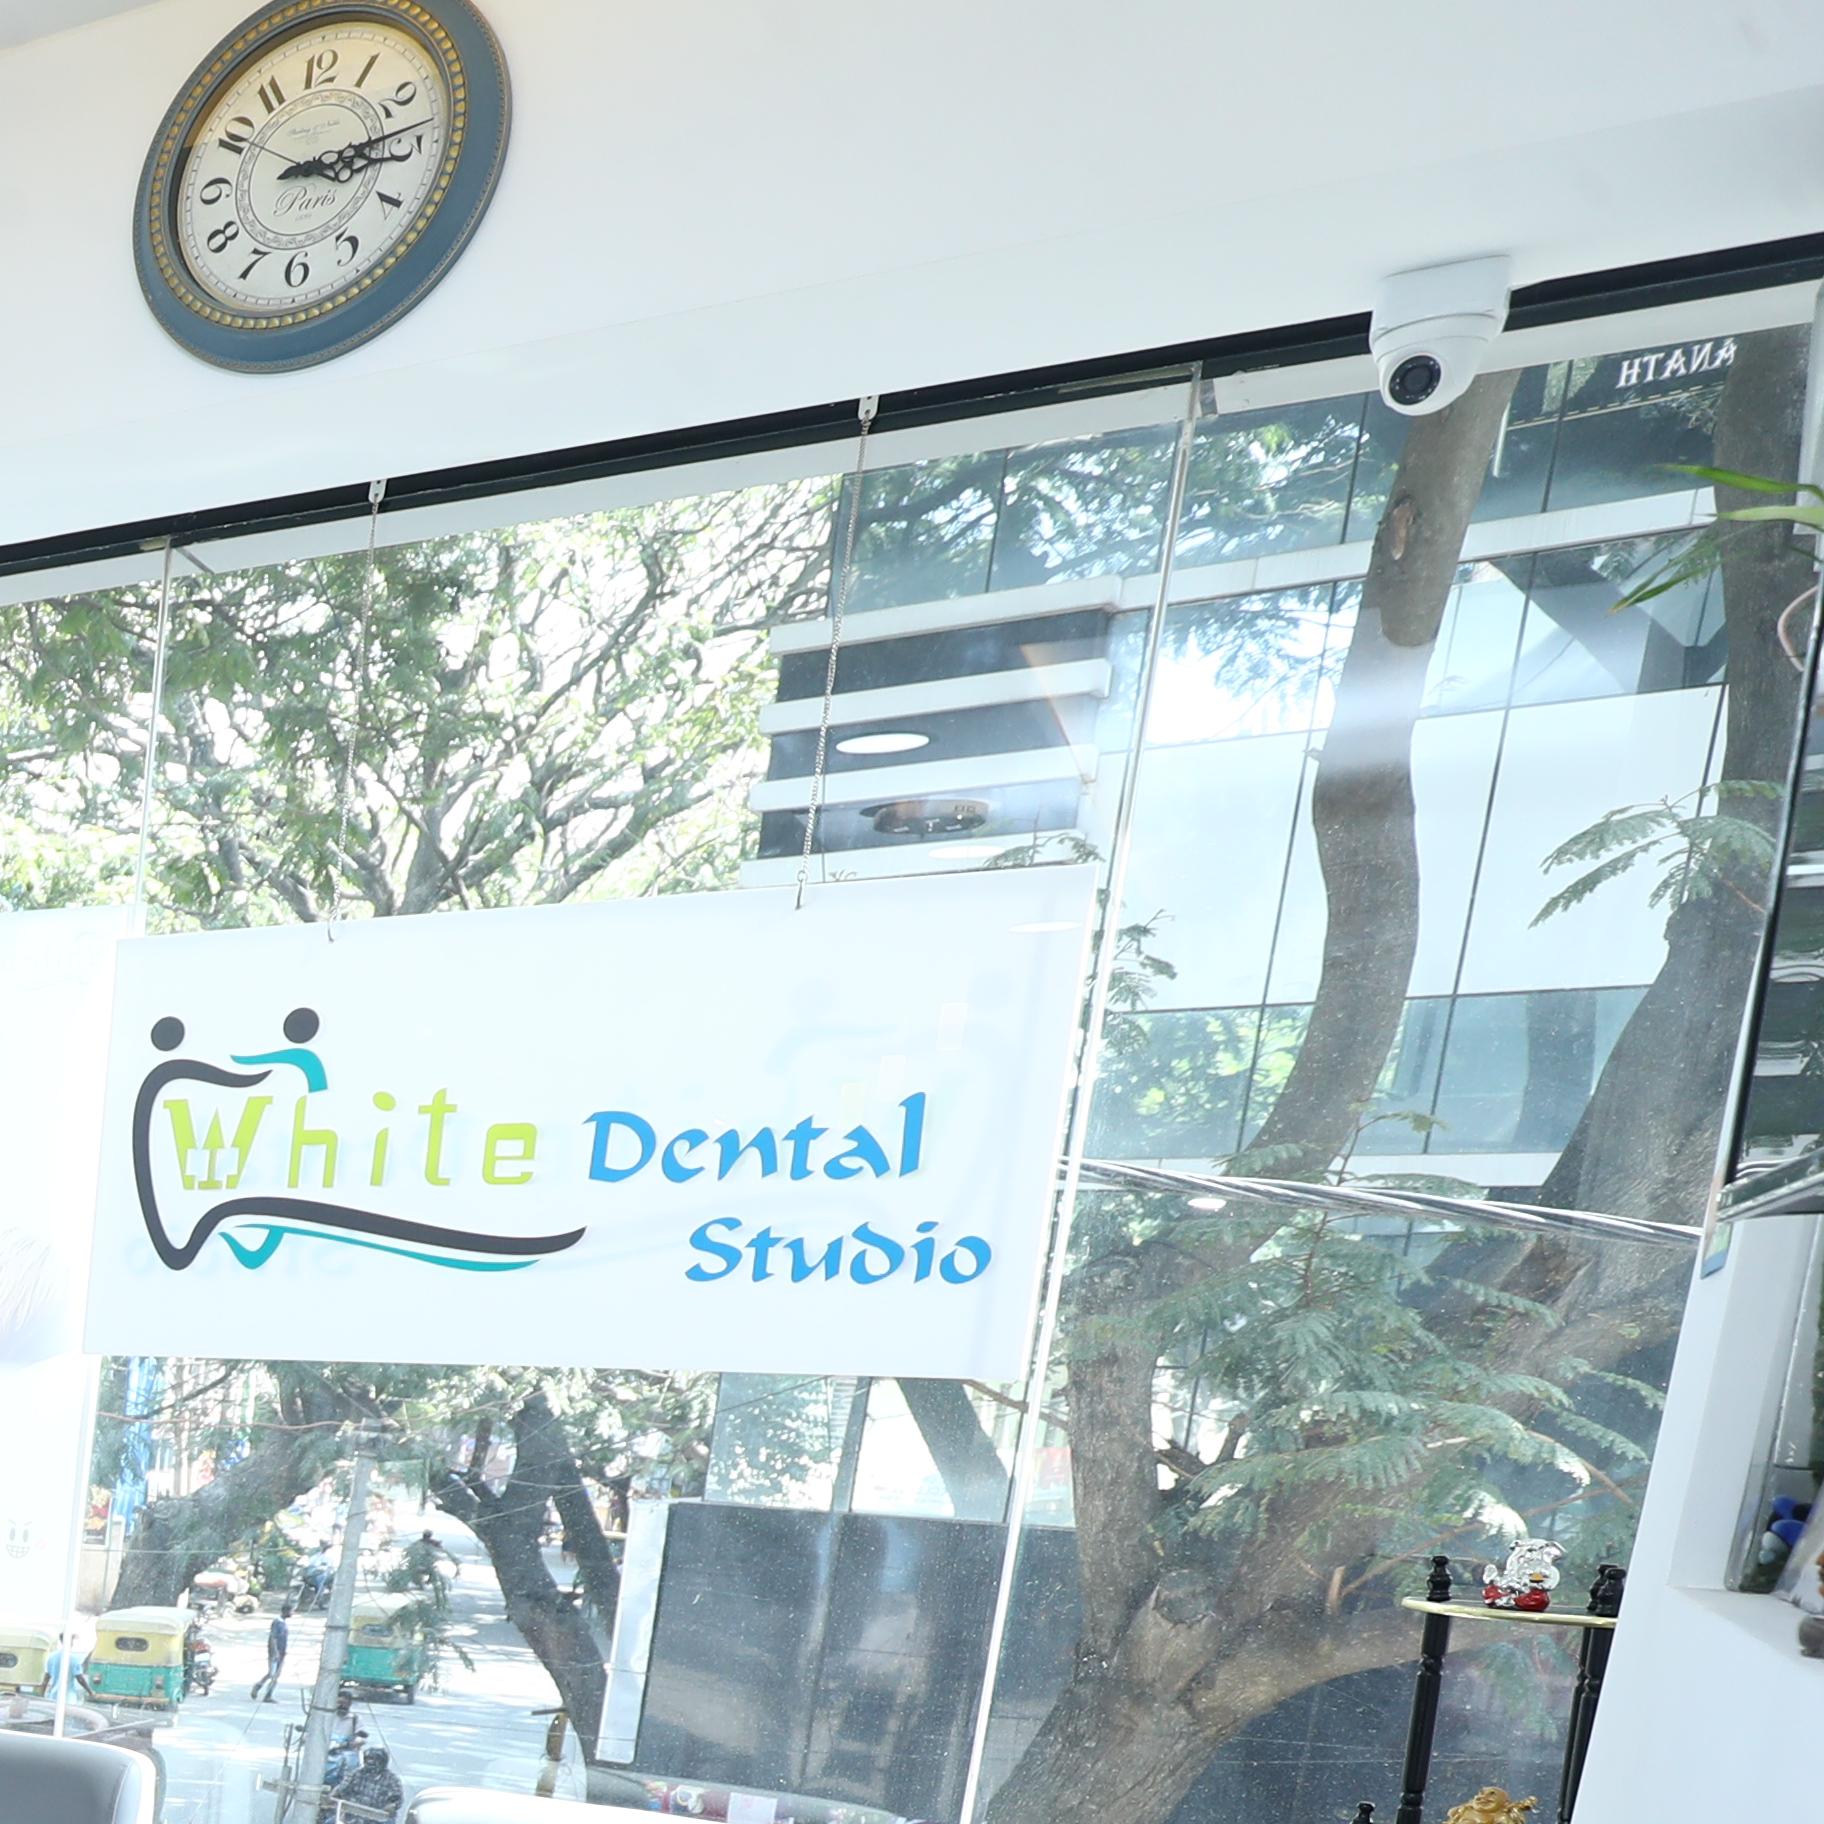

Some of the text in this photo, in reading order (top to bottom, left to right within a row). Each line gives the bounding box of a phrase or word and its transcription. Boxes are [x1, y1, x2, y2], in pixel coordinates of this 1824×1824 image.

[303, 49, 339, 90] 12
[354, 52, 380, 89] 1
[257, 75, 286, 114] 11
[379, 81, 416, 119] 2
[218, 116, 255, 155] 10
[200, 177, 232, 205] 9
[273, 185, 337, 216] Paris
[376, 191, 403, 220] 4
[207, 221, 239, 253] 8
[335, 227, 359, 267] 5
[238, 248, 272, 280] 7
[284, 251, 310, 288] 6
[163, 1088, 927, 1190] White Dental
[685, 1217, 992, 1284] Studio
